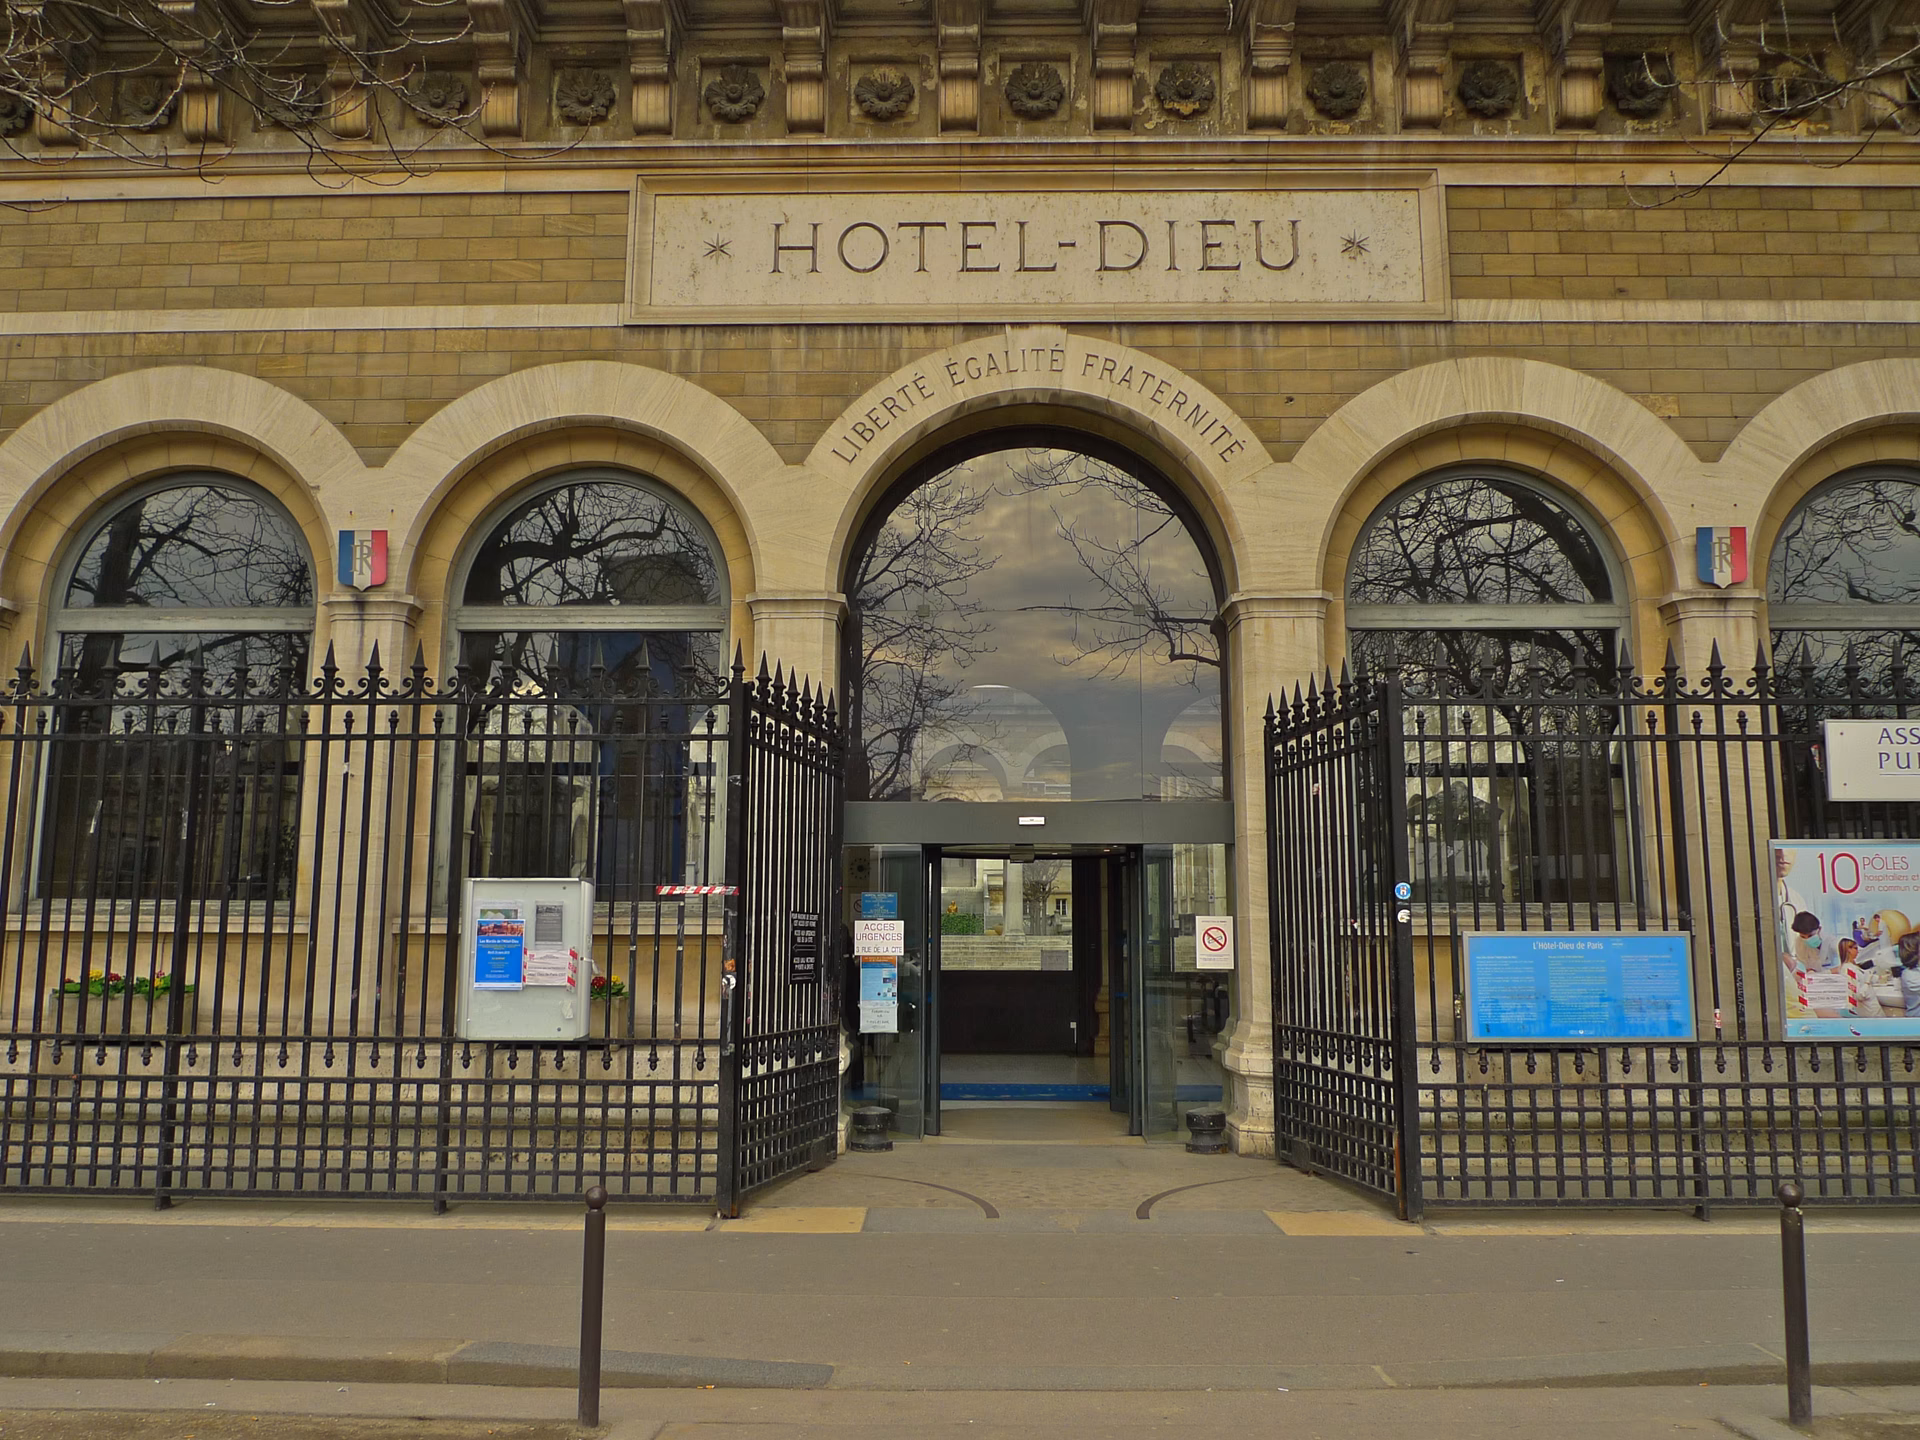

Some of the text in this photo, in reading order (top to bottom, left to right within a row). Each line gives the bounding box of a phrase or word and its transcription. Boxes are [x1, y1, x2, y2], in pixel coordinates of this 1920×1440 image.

[768, 219, 1302, 274] HOTEL-DIEU
[831, 343, 1247, 465] LIBERTÉ ÉGALITÉ FRATERNITÉ
[1862, 853, 1909, 870] PÔLES
[1817, 852, 1861, 894] 10
[1863, 873, 1909, 883] hospitaliers
[864, 923, 895, 931] ACCES
[856, 933, 902, 941] URGENCES
[1576, 941, 1585, 950] de
[1587, 941, 1604, 950] Paris
